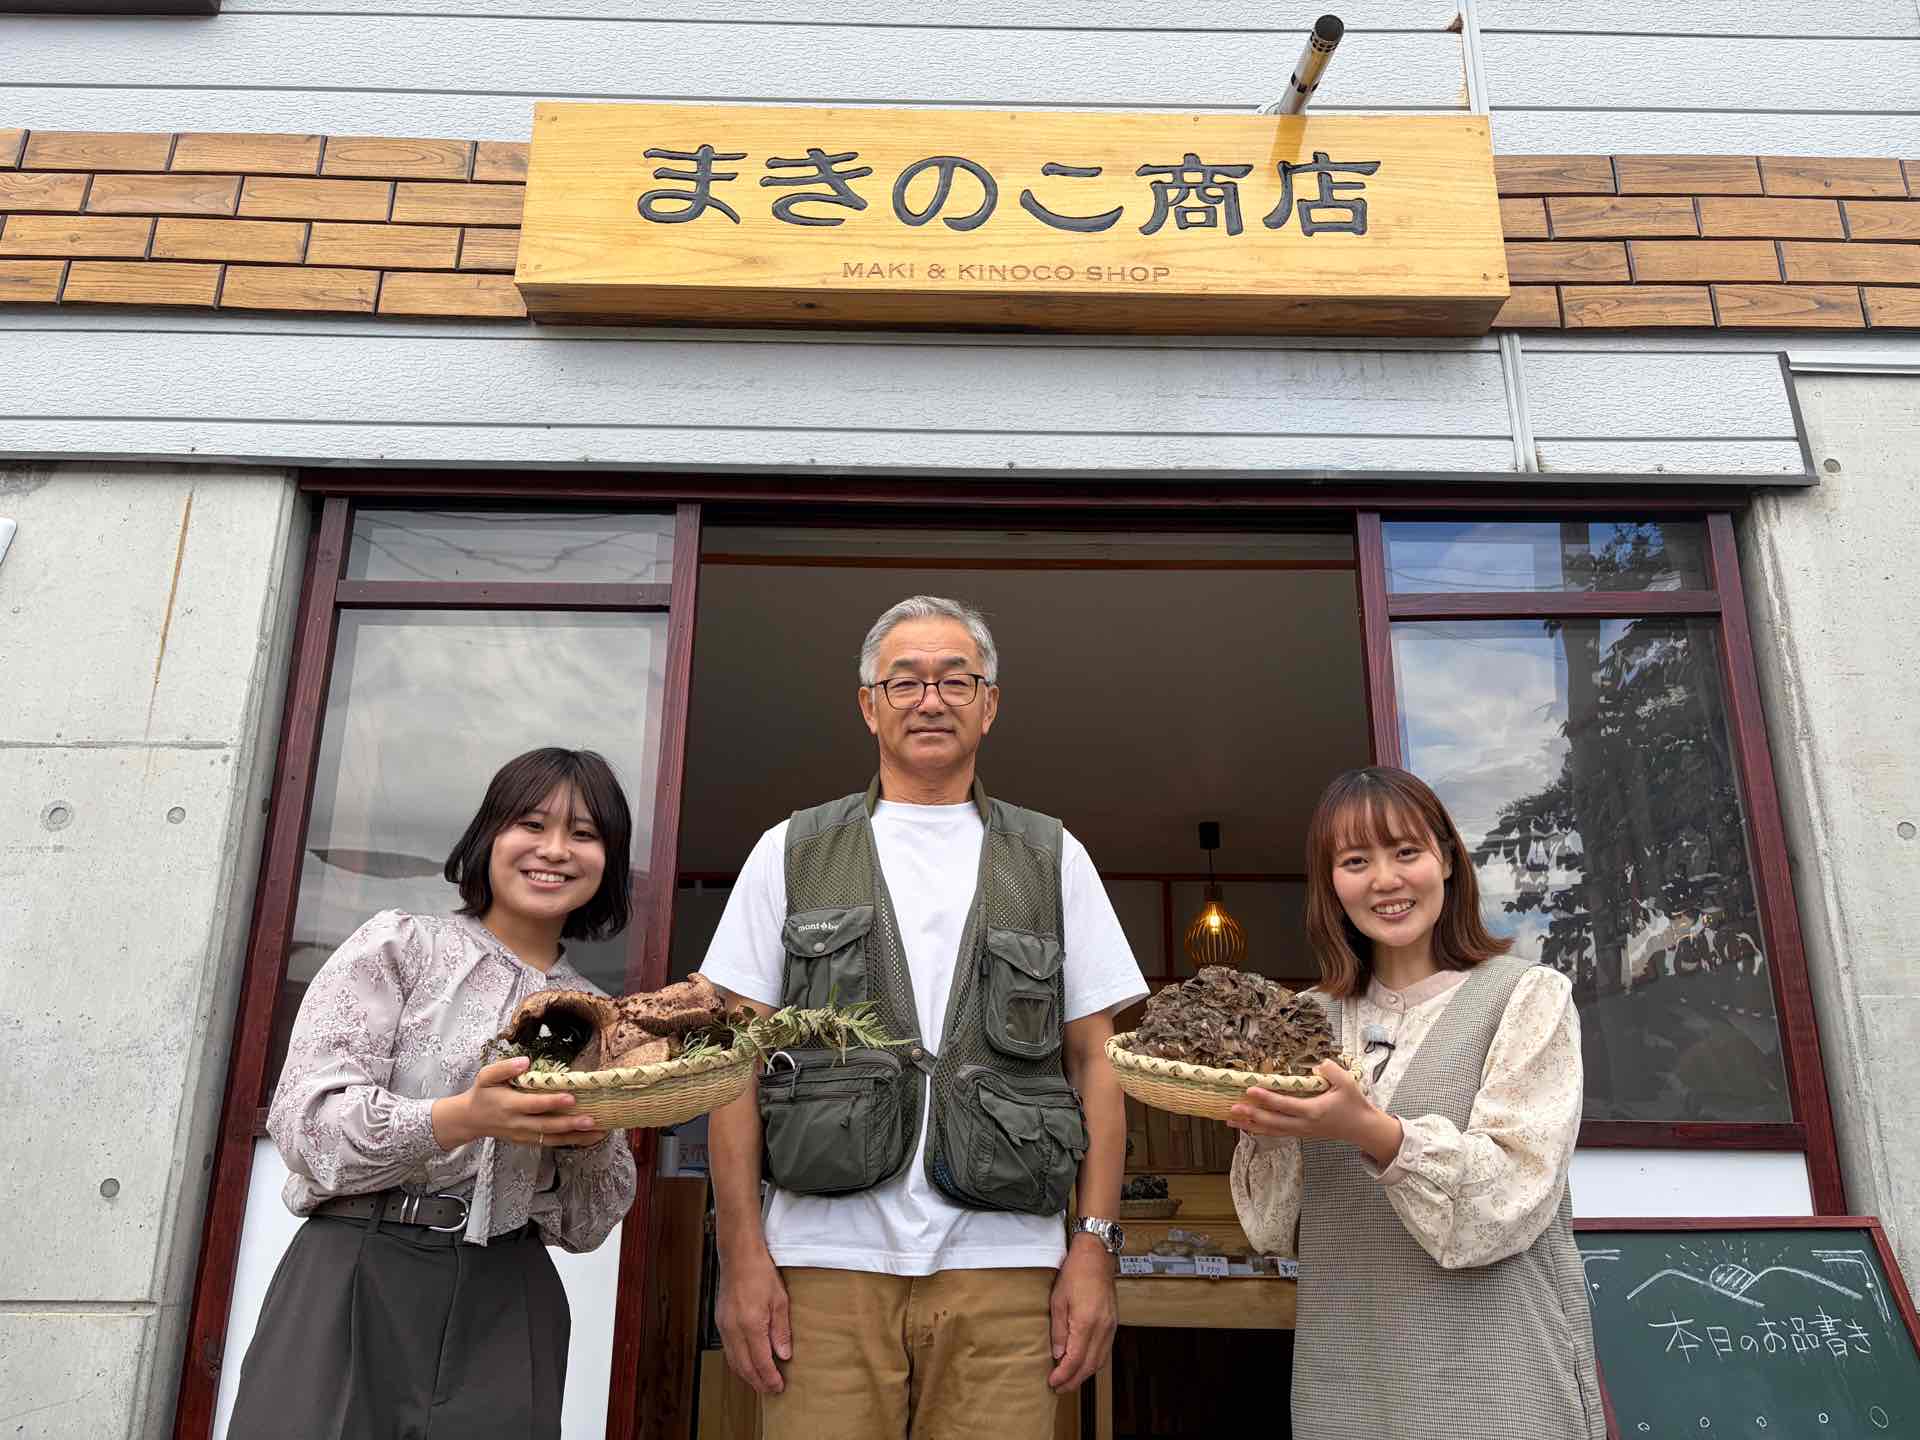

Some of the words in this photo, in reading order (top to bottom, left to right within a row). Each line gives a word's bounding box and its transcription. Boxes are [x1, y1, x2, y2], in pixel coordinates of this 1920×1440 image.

[637, 144, 1381, 237] まきのこ商店
[842, 262, 914, 279] MAKI
[927, 263, 945, 279] &
[958, 264, 1074, 281] KINOCO
[1086, 266, 1171, 282] SHOP
[1648, 1305, 1872, 1363] 本日のお品書き
